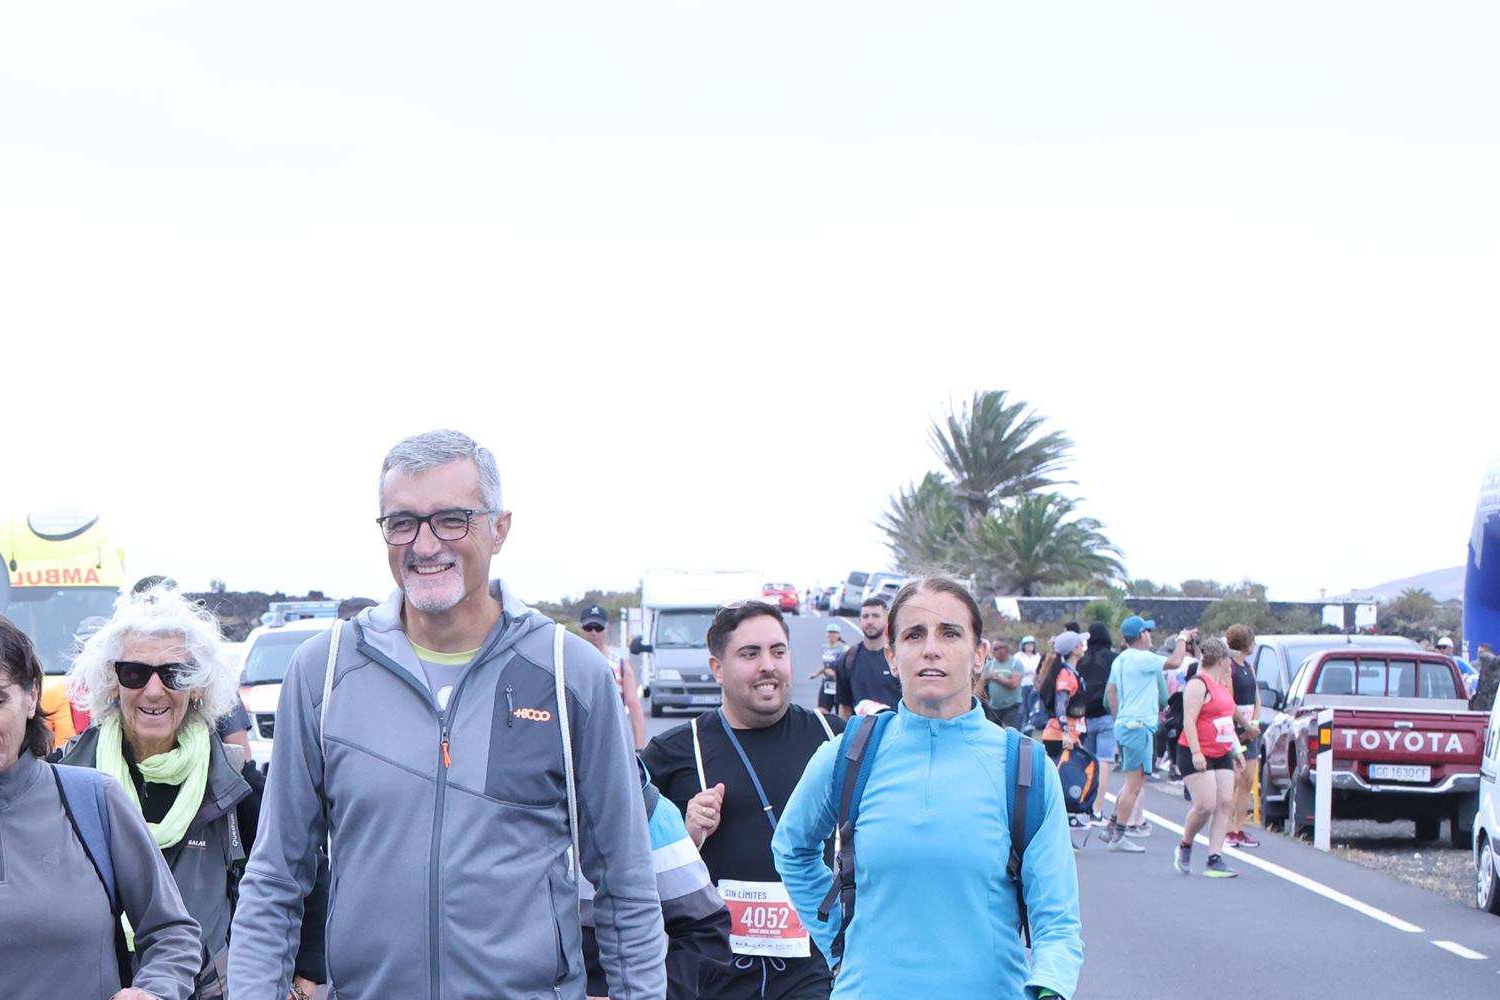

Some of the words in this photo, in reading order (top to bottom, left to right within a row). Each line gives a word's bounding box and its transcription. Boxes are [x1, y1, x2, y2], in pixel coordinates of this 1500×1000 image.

[1341, 729, 1464, 753] TOYOTA
[725, 889, 737, 898] SIN
[738, 890, 767, 900] LÍMITES
[740, 906, 789, 929] 4052
